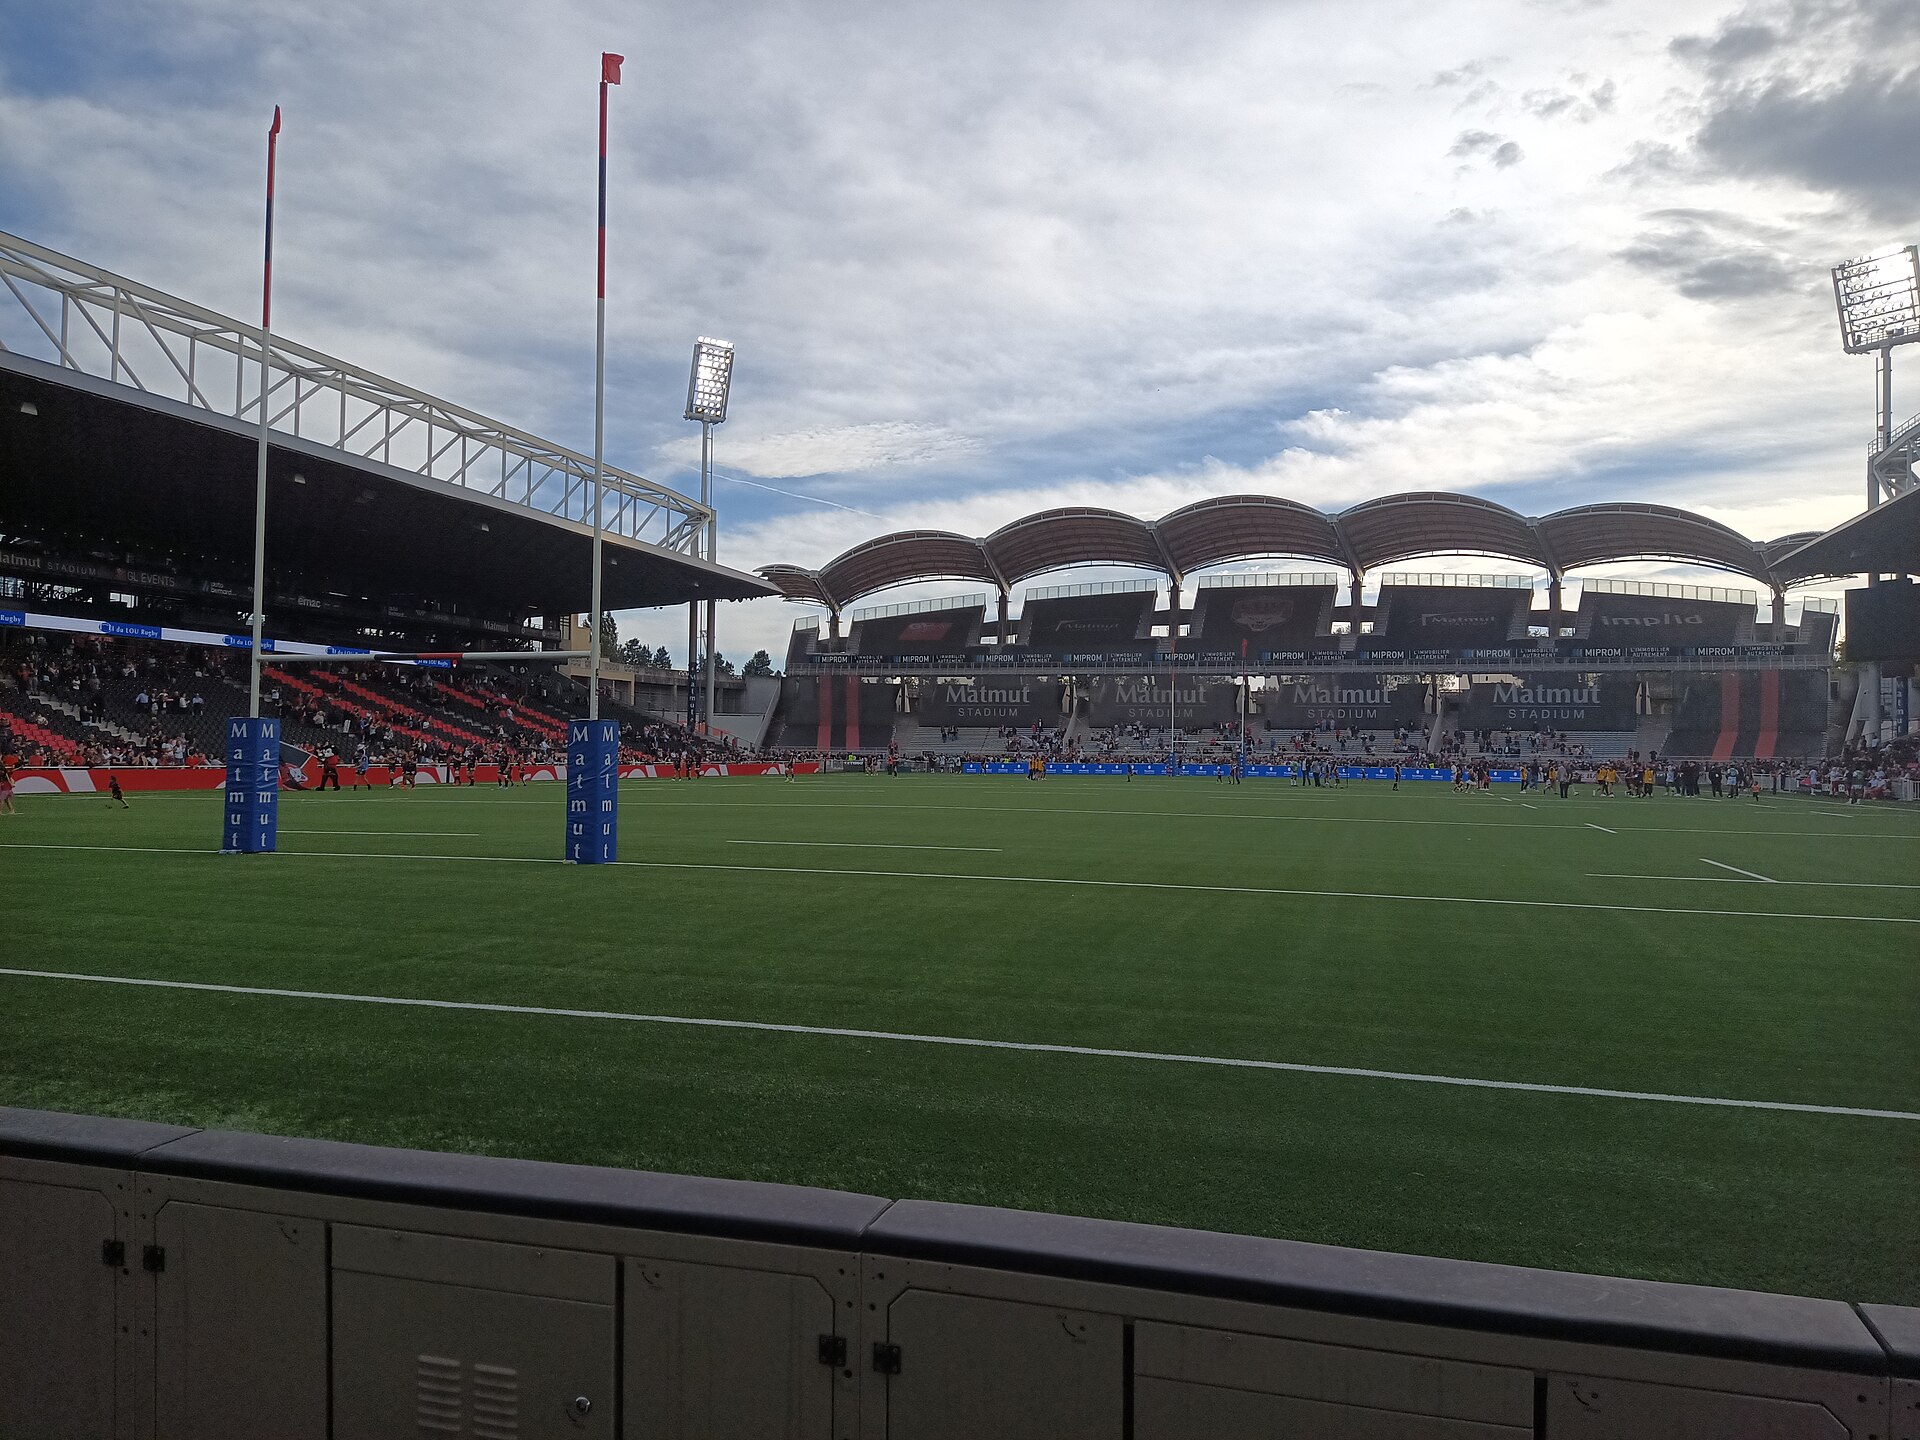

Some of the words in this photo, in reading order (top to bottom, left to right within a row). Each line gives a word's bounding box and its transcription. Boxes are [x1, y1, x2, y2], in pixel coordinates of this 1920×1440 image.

[0, 552, 41, 569] atmut
[47, 561, 96, 576] STADIUM
[127, 571, 138, 582] GL
[140, 572, 176, 588] EVENTS
[0, 614, 22, 625] Rugby
[140, 629, 159, 638] Rugby
[1272, 652, 1304, 660] MIPROM
[1371, 651, 1404, 659] MIPROM
[1476, 649, 1511, 657] MIPROM
[1584, 648, 1621, 657] MIPROM
[1697, 647, 1734, 656] MIPROM
[902, 655, 930, 663] MIPROM
[985, 654, 1014, 662] MIPROM
[1073, 654, 1102, 662] MIPROM
[1164, 653, 1195, 661] MIPROM
[945, 685, 1030, 703] Matmut
[1115, 685, 1207, 704] Matmut
[1293, 684, 1391, 704] Matmut
[1493, 684, 1601, 704] Matmut
[958, 708, 1018, 717] STADIUM
[1128, 708, 1193, 718] STADIUM
[1307, 709, 1377, 719] STADIUM
[1508, 709, 1585, 719] STADIUM
[229, 723, 247, 847] Matmut
[259, 723, 274, 847] Matmut
[571, 726, 588, 859] Matmut
[602, 726, 614, 859] Matmut
